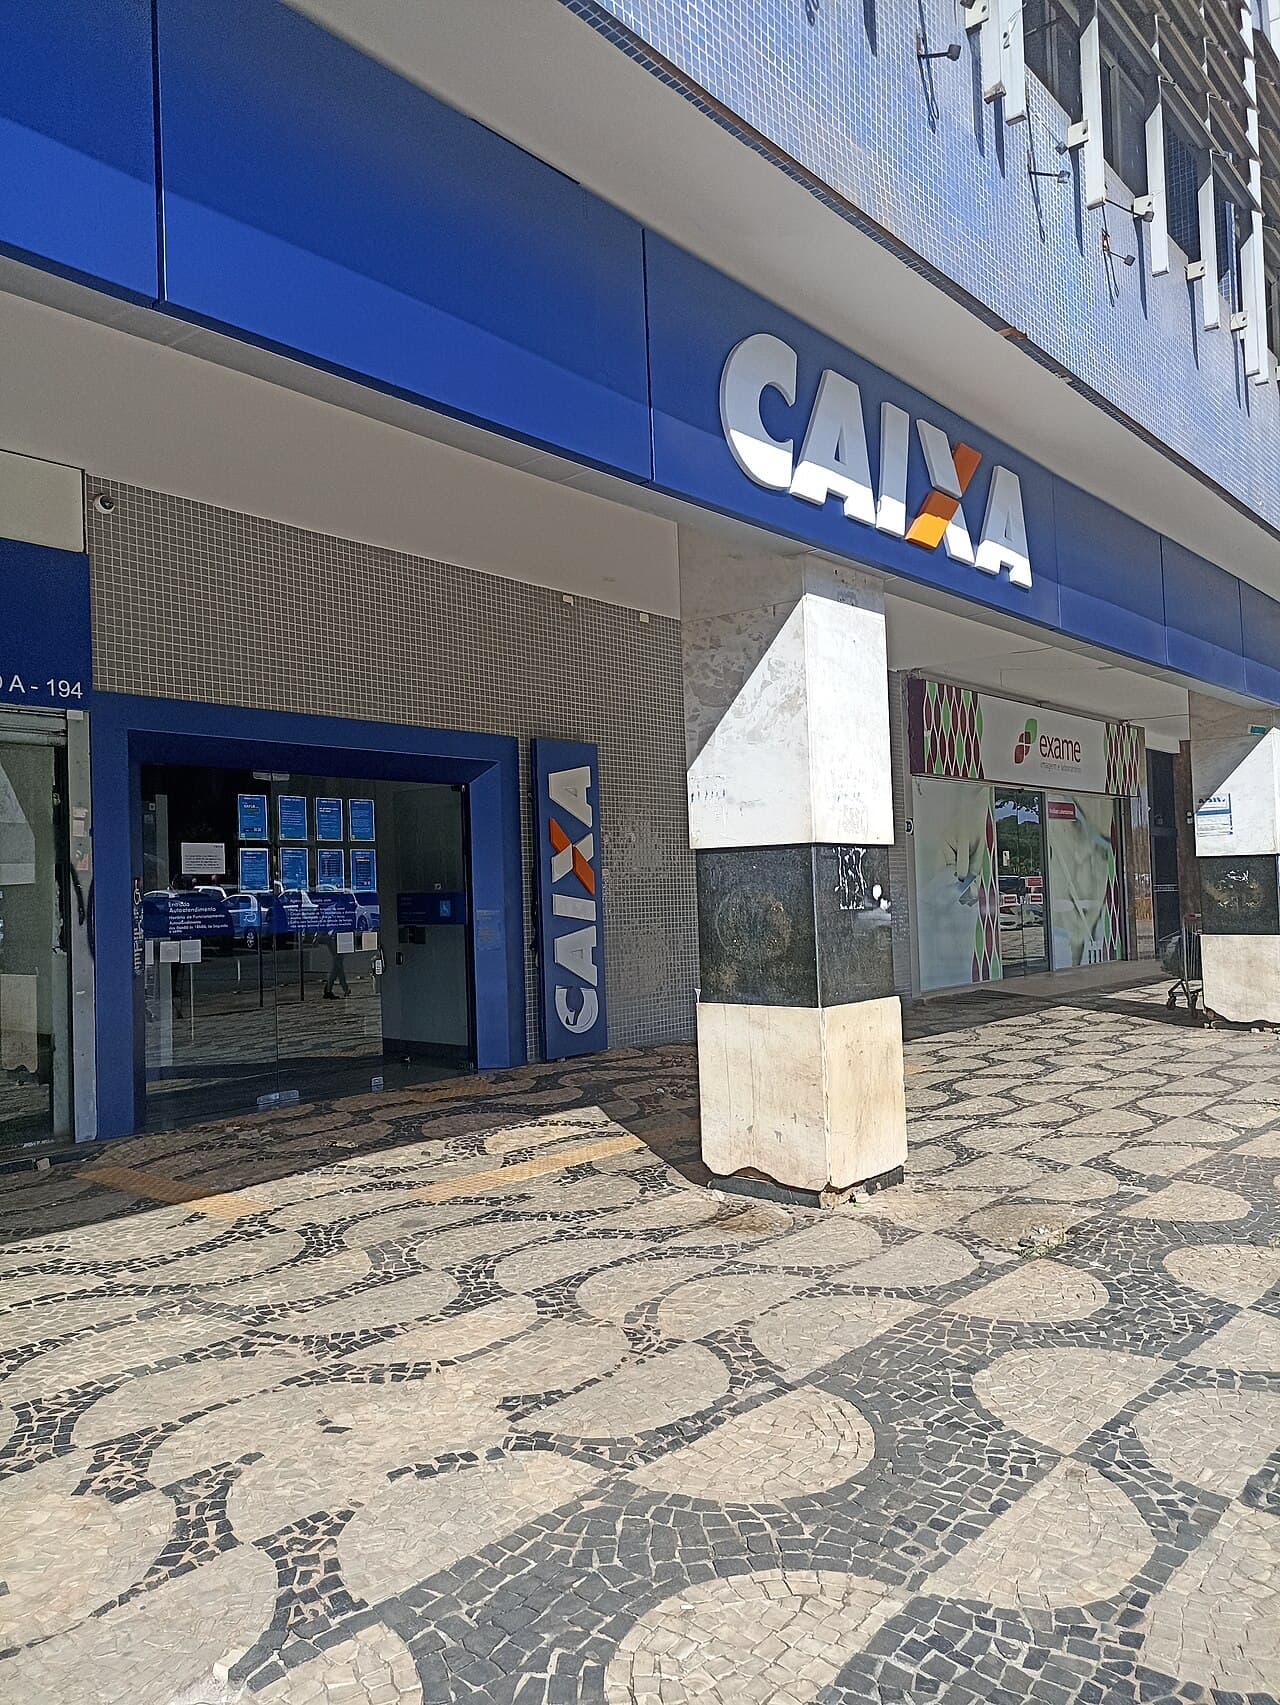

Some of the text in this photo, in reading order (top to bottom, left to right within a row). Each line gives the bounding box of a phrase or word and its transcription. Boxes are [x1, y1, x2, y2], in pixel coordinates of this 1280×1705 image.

[719, 333, 1033, 589] CAIXA
[8, 674, 26, 693] A
[46, 678, 84, 699] 194
[1039, 734, 1081, 763] exame
[548, 765, 599, 1034] CAIXA
